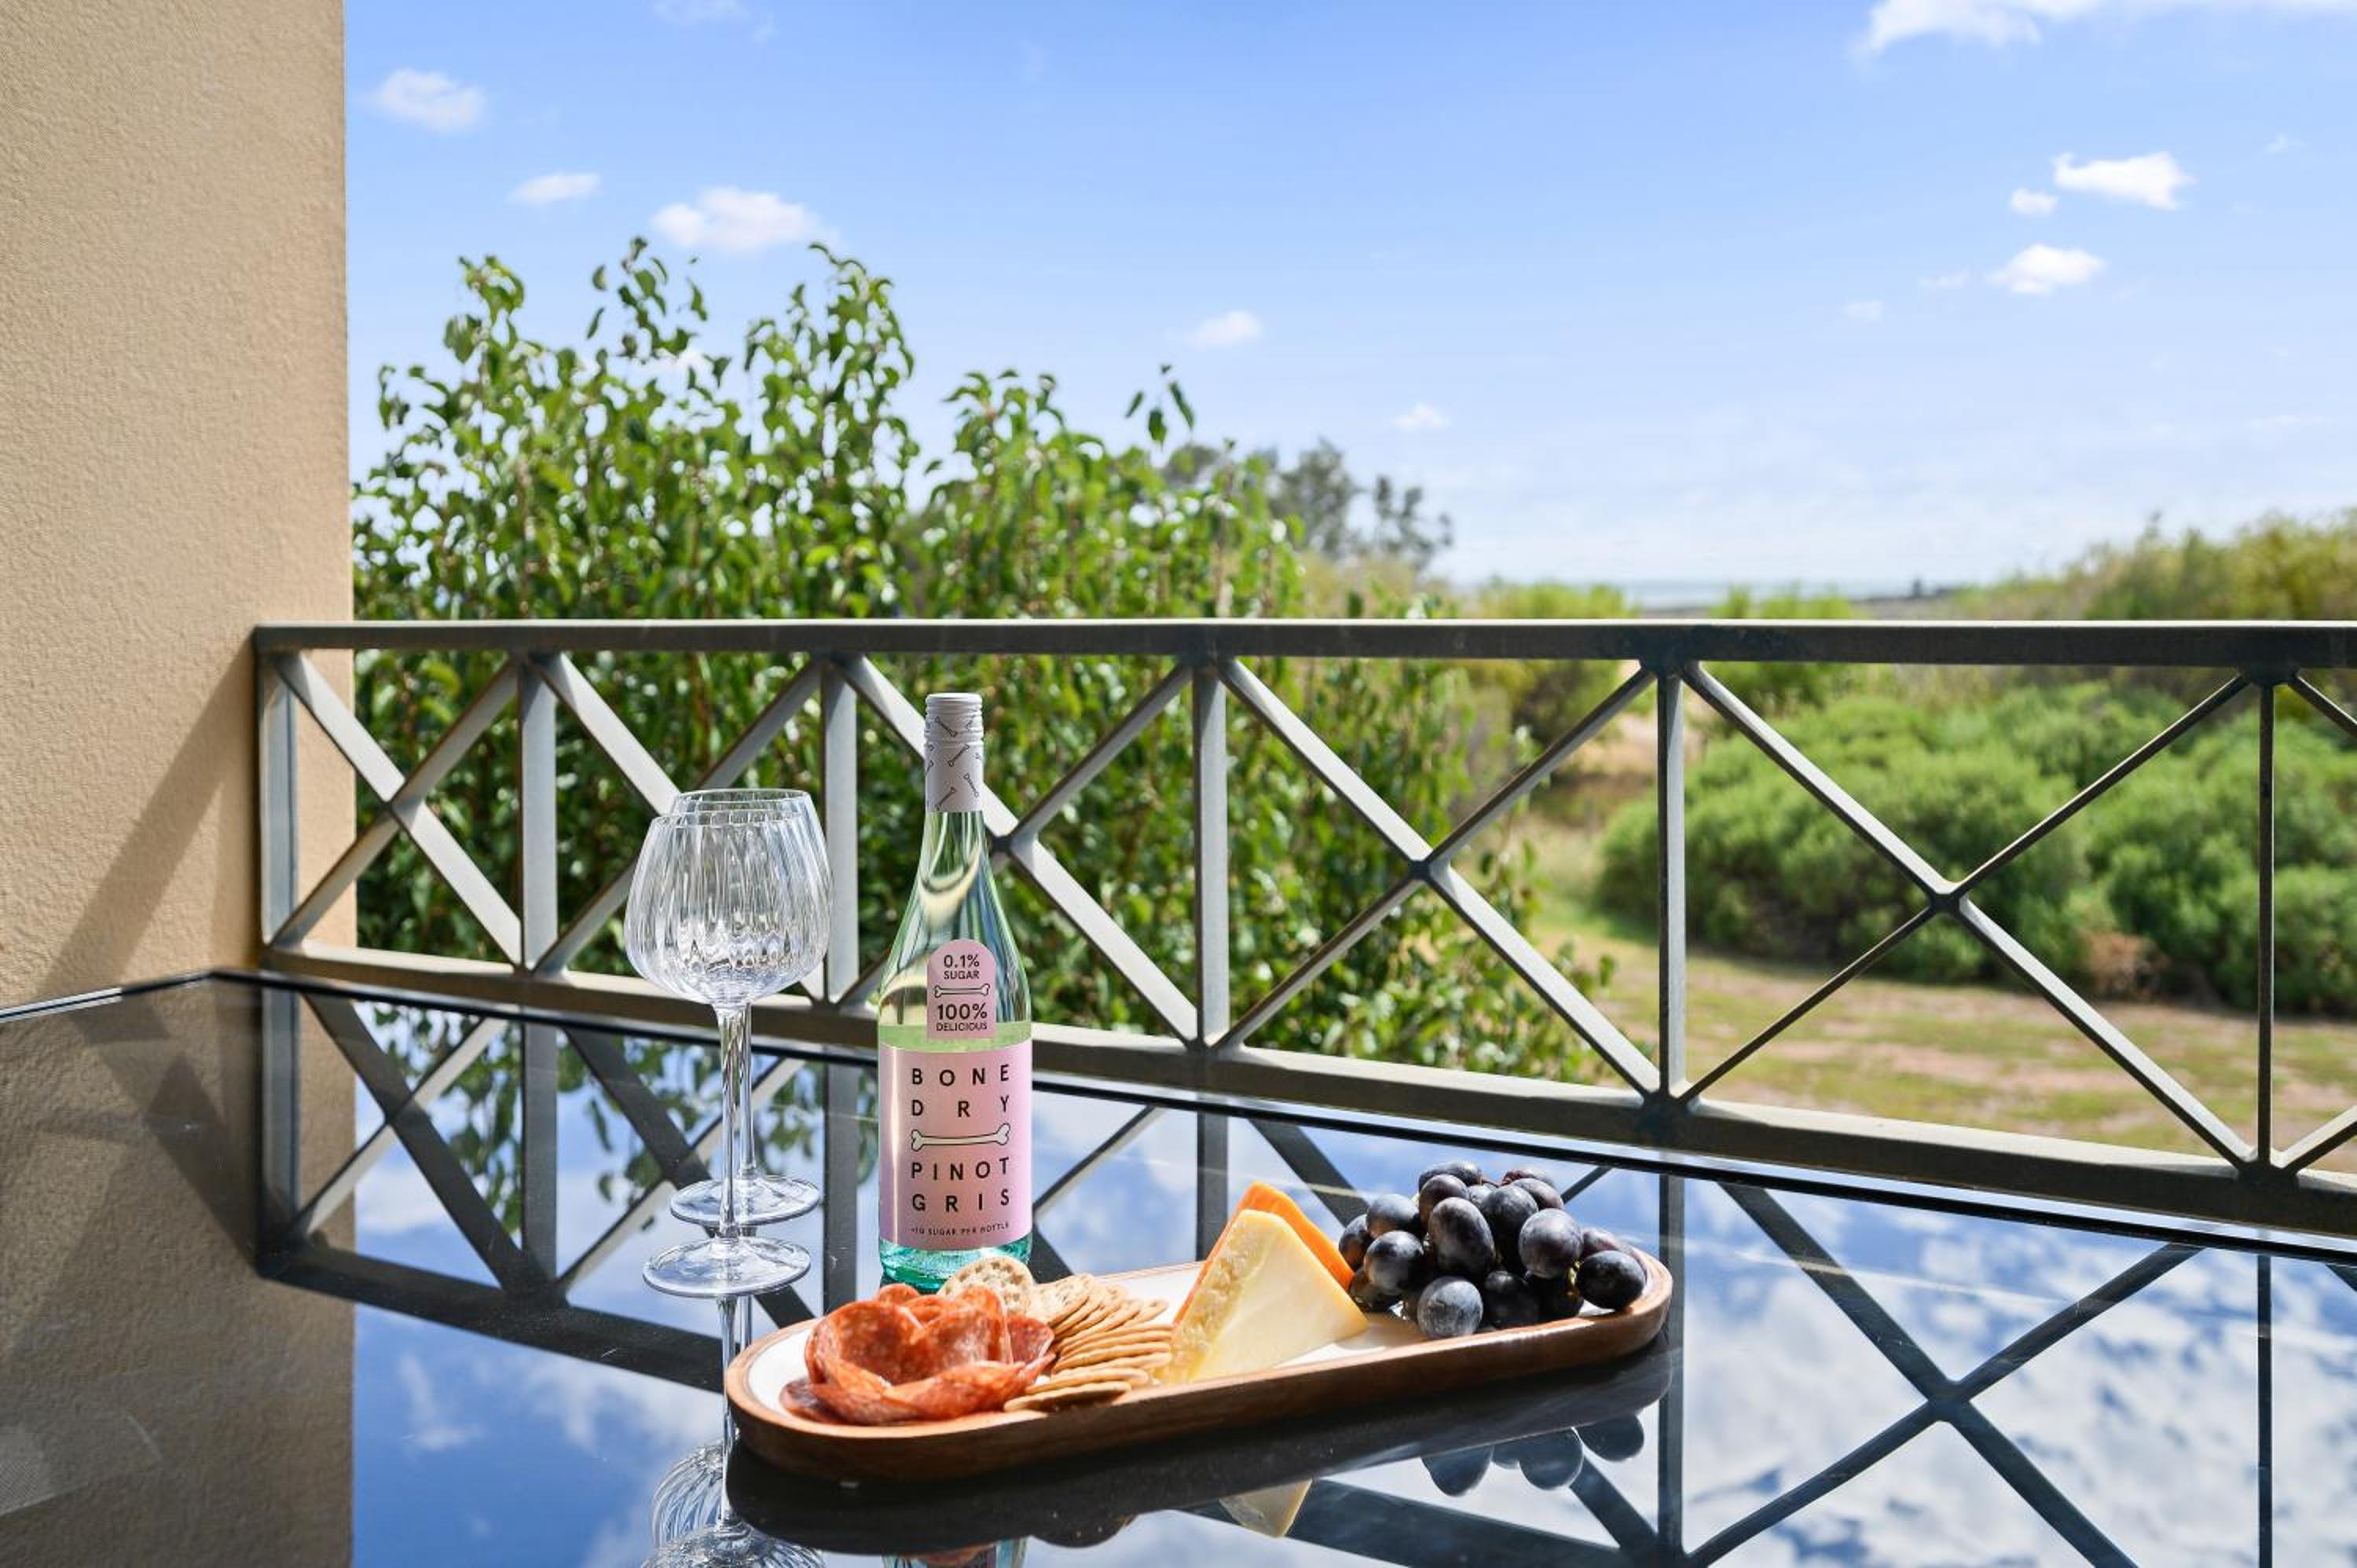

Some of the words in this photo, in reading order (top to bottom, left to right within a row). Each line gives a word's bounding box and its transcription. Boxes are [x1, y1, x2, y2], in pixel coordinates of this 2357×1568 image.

[944, 954, 980, 968] 0.1%
[944, 970, 980, 980] SUGAR
[937, 1002, 988, 1020] 100%
[936, 1022, 988, 1031] DELICIOUS
[912, 1064, 1010, 1086] BONE
[912, 1095, 1010, 1117] DRY
[911, 1156, 1010, 1180] PINOT
[912, 1189, 1010, 1212] GRIS
